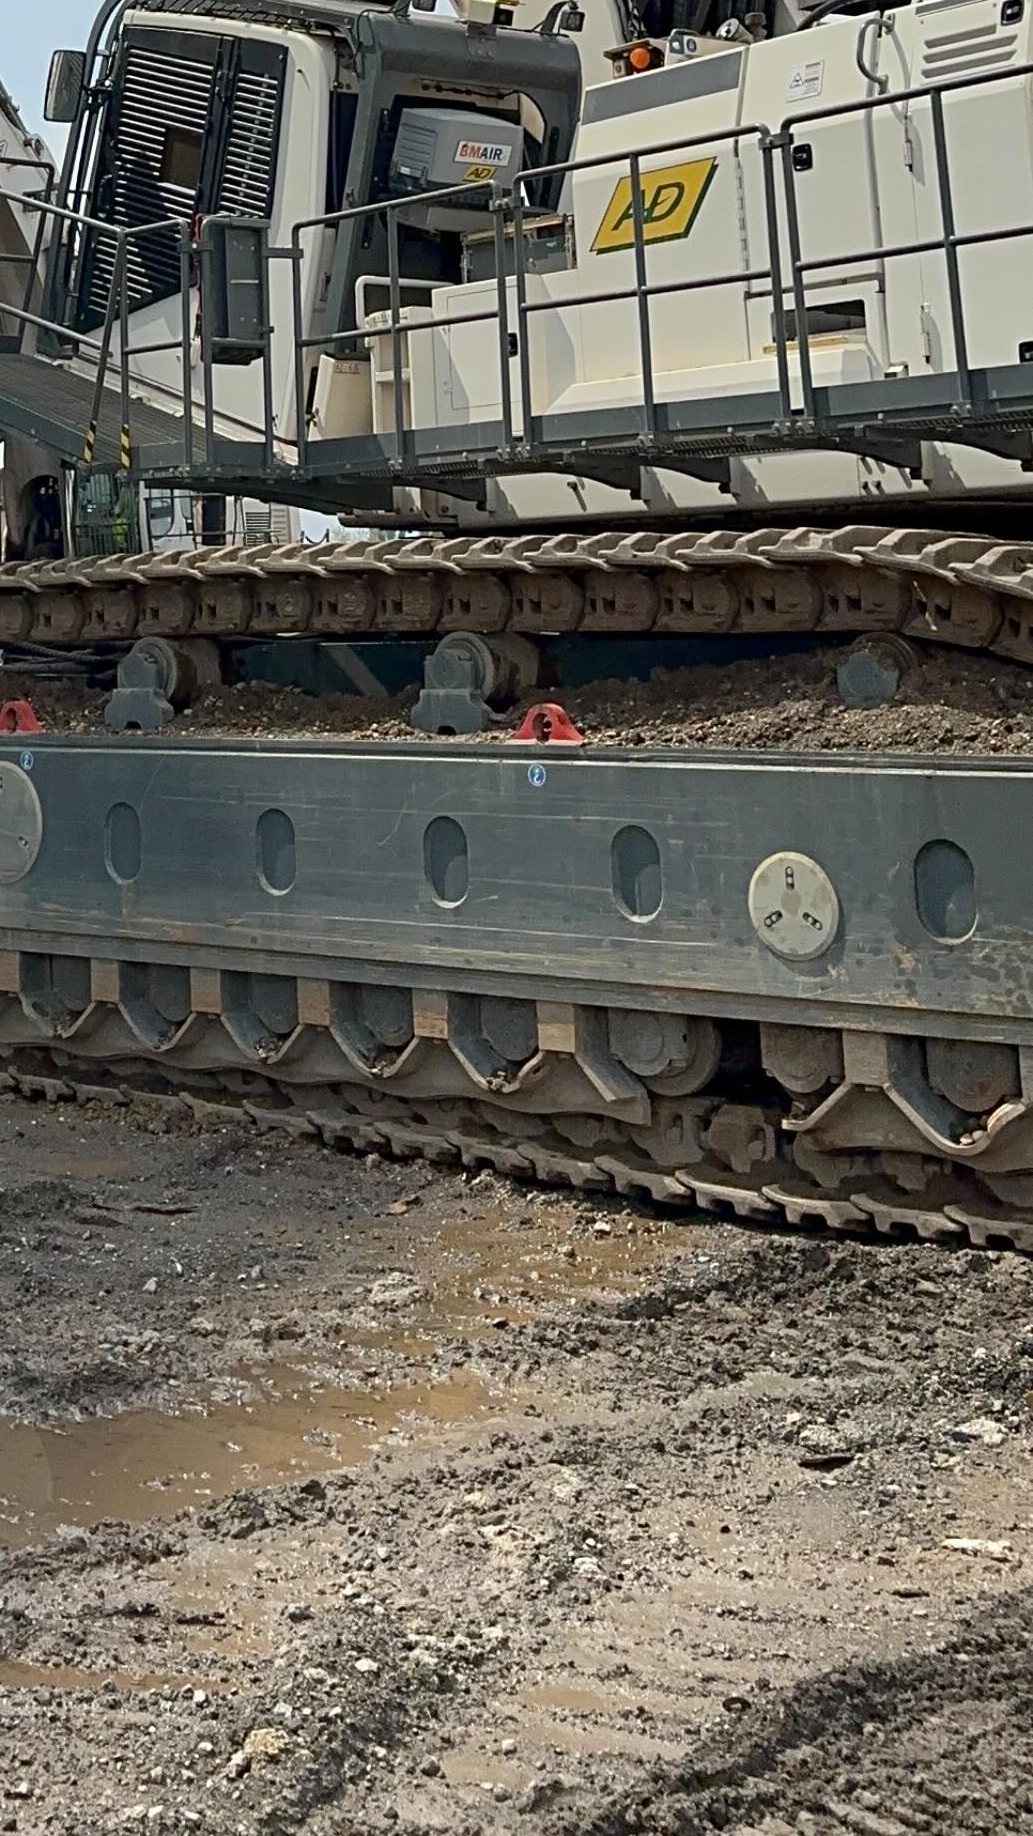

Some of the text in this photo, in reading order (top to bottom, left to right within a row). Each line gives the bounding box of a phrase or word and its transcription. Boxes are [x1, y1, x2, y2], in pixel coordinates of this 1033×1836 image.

[459, 144, 503, 161] BMAIR
[467, 167, 492, 179] AD
[611, 181, 685, 232] AD
